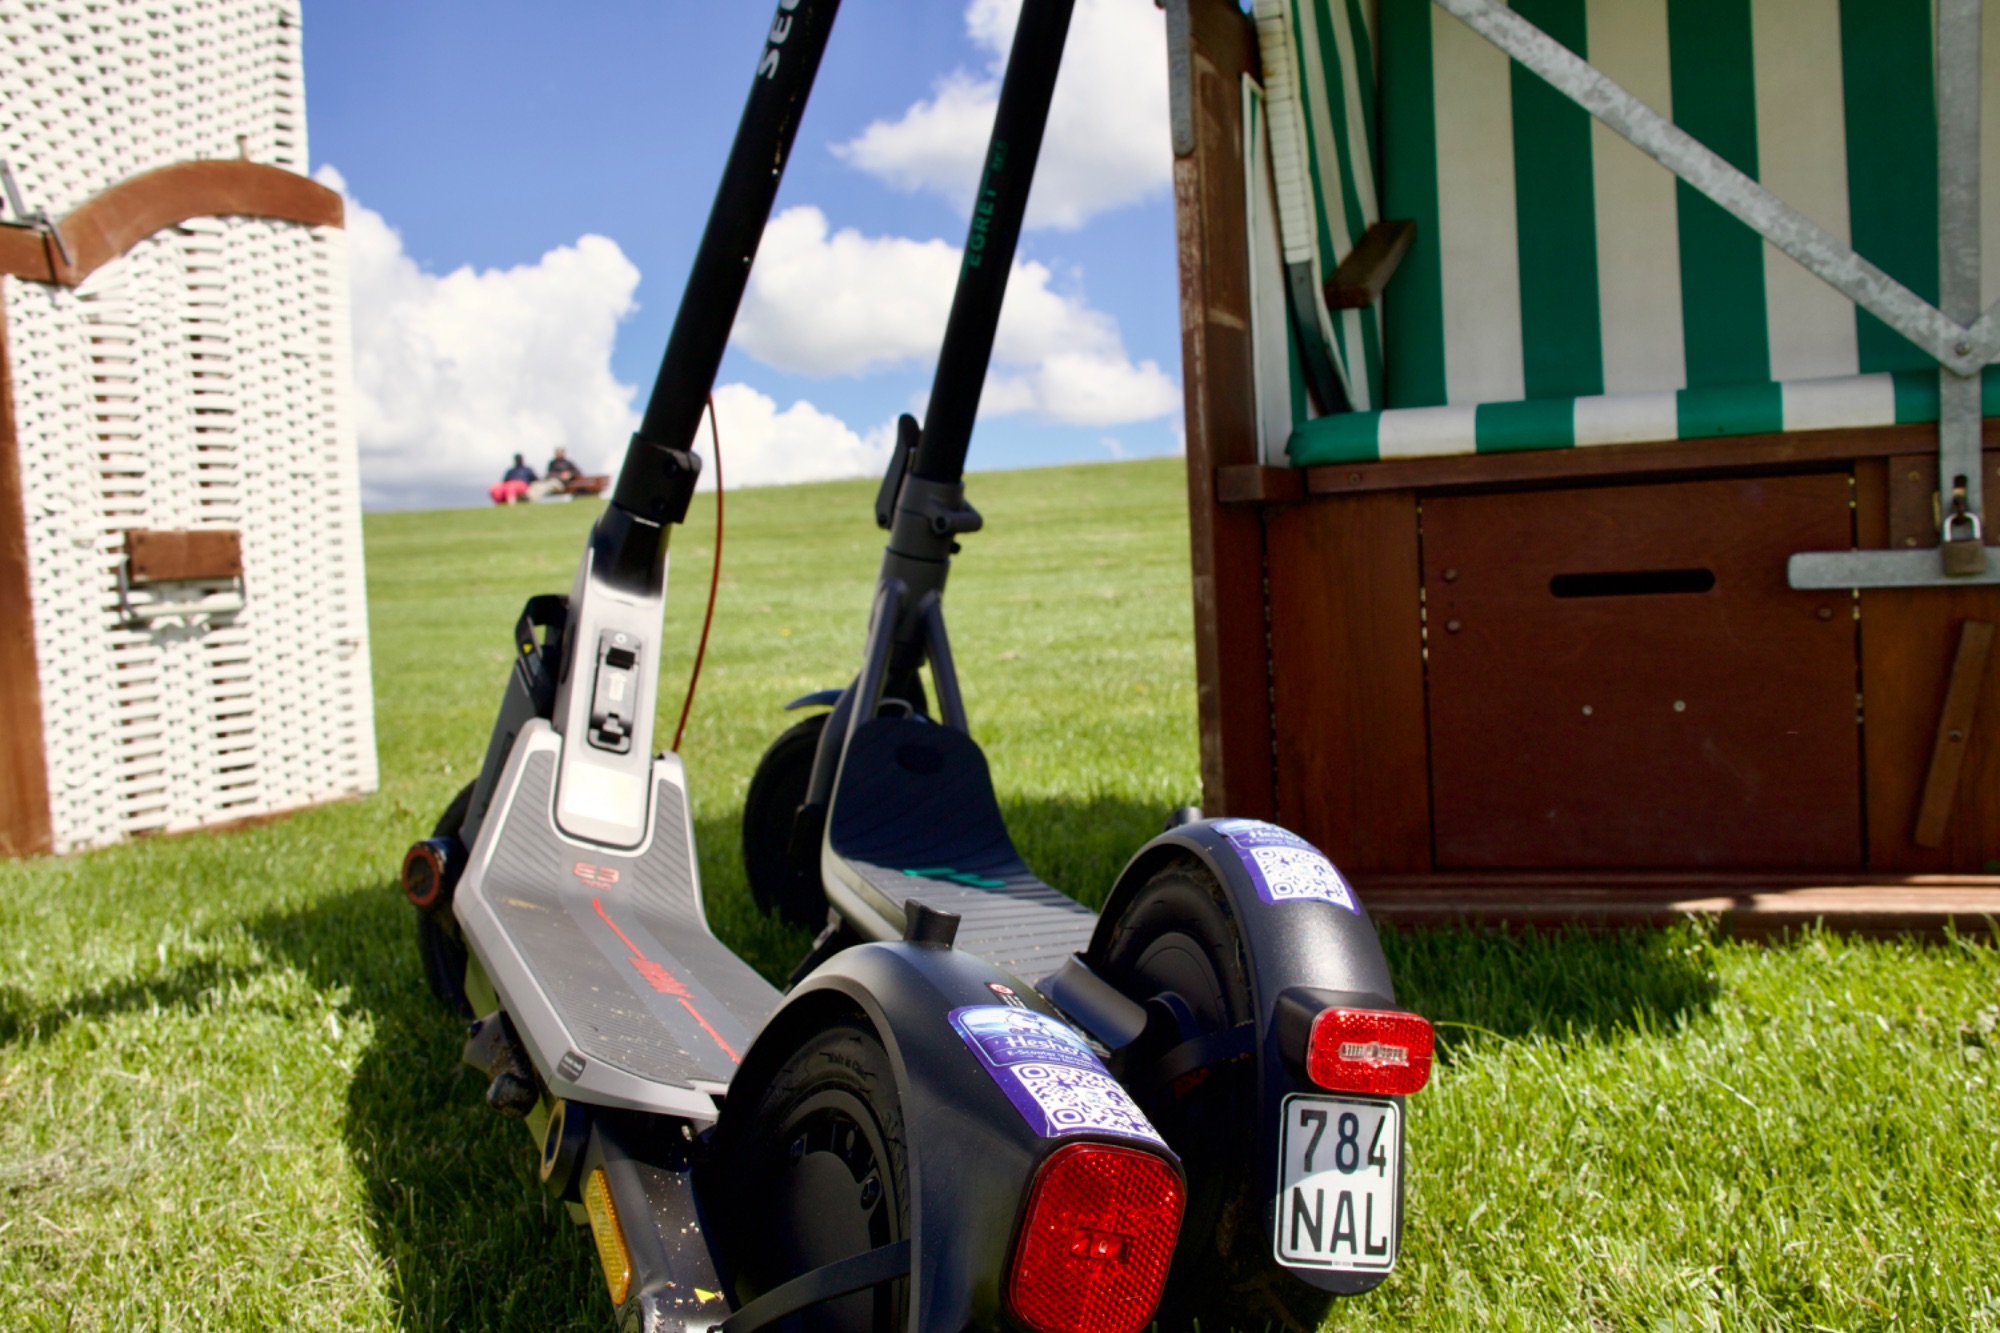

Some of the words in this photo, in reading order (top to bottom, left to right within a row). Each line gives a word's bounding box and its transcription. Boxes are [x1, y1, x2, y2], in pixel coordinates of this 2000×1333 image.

[960, 171, 998, 282] EGRET
[573, 862, 620, 884] E3
[1301, 1109, 1387, 1178] 784
[1290, 1187, 1387, 1256] NAL
